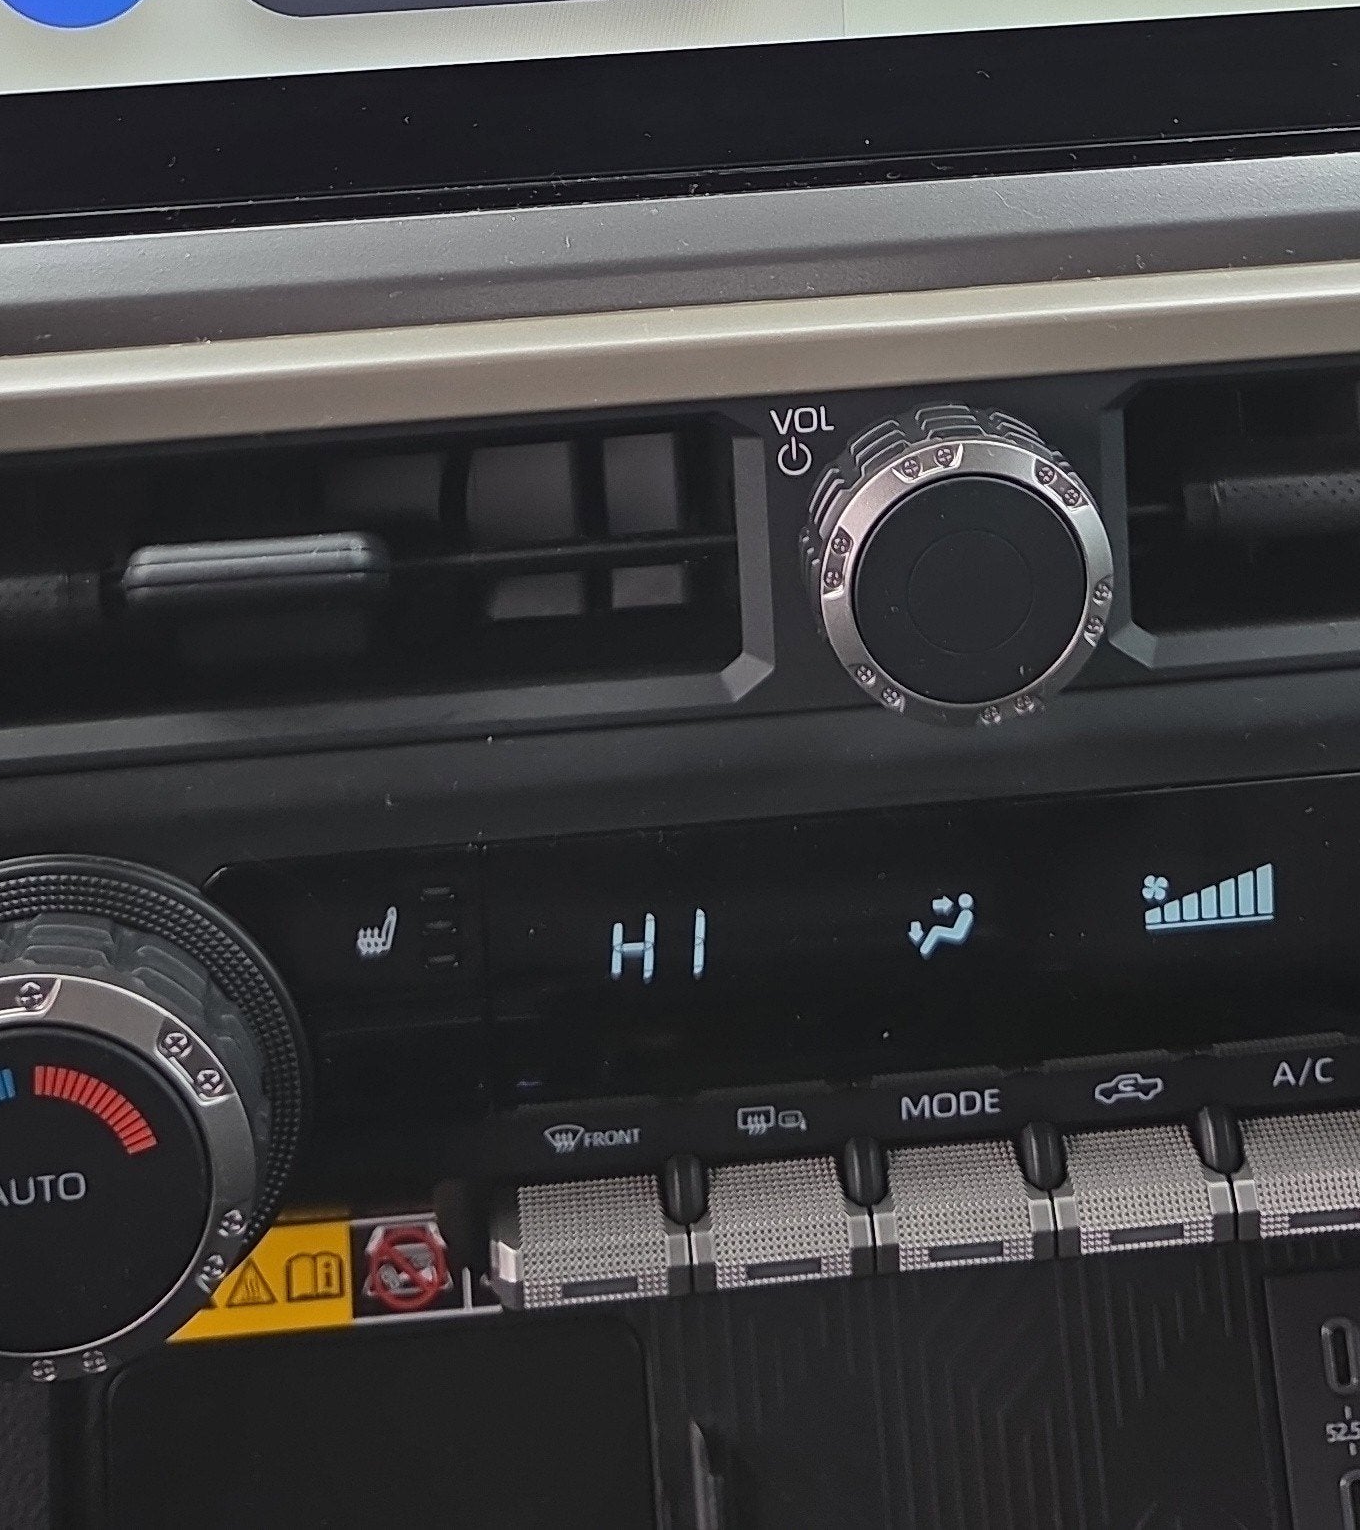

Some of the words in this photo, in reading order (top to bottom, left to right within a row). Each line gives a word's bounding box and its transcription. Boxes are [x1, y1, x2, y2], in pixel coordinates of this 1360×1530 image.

[769, 405, 835, 435] VOL
[1272, 1057, 1334, 1088] A/C
[901, 1088, 1001, 1121] MODE
[583, 1128, 640, 1148] FRONT
